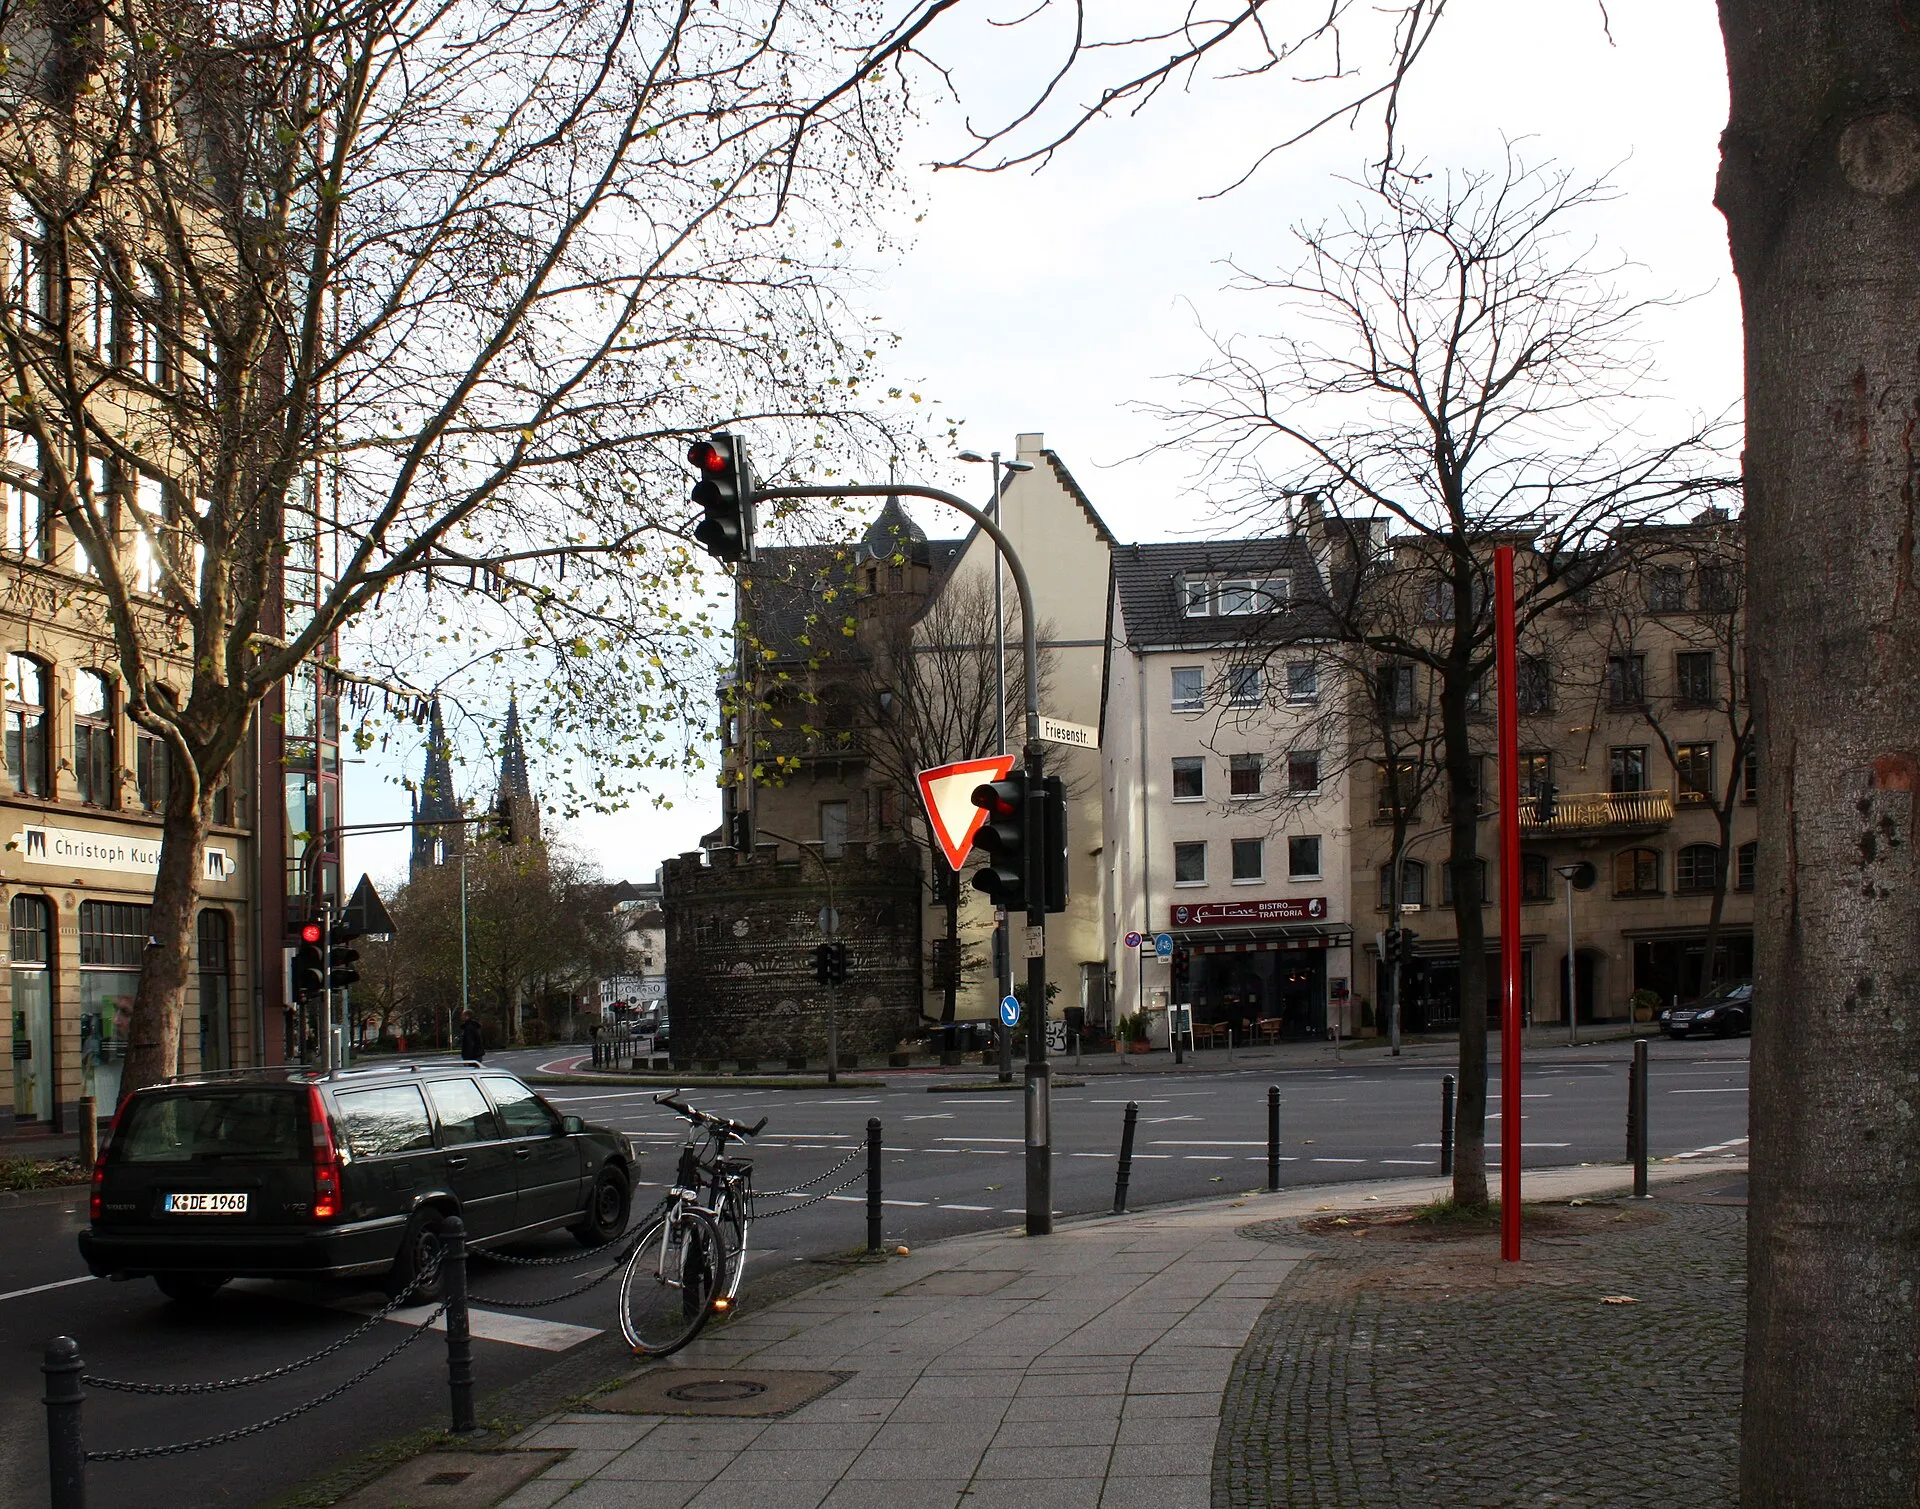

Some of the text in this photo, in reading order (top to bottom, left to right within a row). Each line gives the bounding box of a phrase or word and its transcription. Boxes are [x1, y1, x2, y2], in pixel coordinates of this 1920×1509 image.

[1045, 720, 1089, 744] Friesenstr.
[55, 839, 124, 866] Christoph
[1258, 902, 1289, 910] BISTRO
[1258, 909, 1303, 918] TRATTORIA
[210, 1195, 246, 1210] 1968
